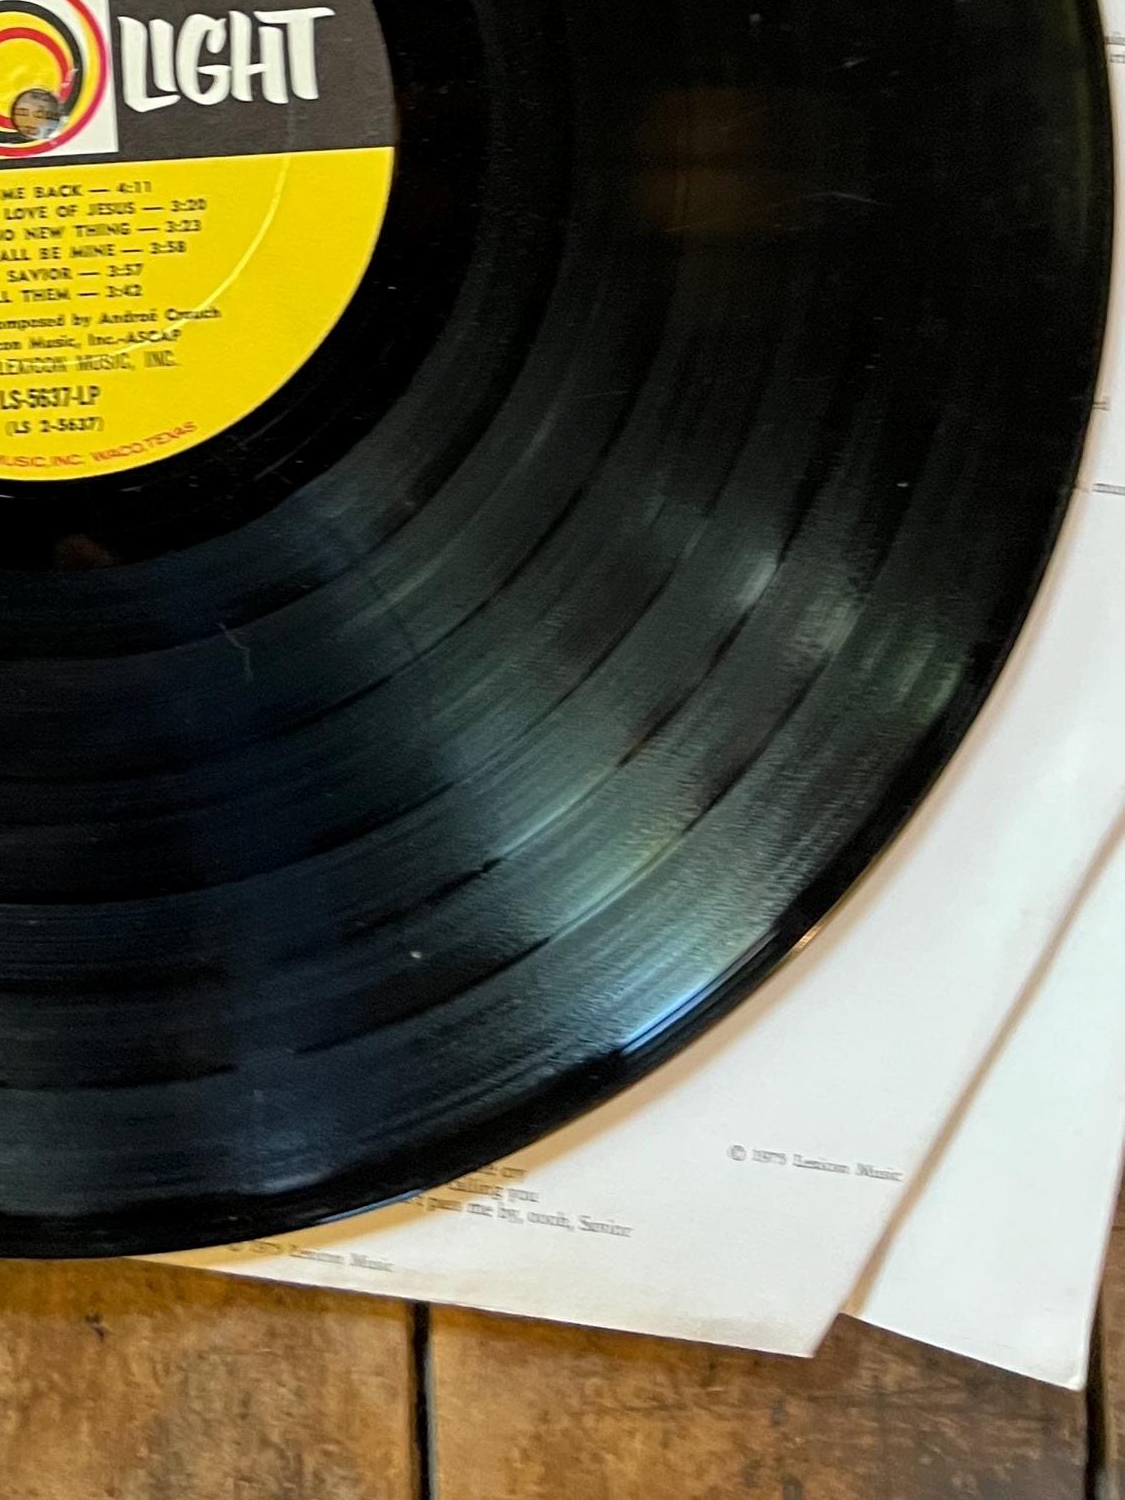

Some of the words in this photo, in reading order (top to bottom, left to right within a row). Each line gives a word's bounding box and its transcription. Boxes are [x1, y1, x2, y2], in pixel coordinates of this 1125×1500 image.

[117, 7, 336, 113] LIGHT
[0, 187, 25, 200] ME
[33, 185, 83, 199] BACK
[116, 181, 152, 194] 4:11
[4, 206, 47, 220] LOVE
[56, 205, 78, 217] OF
[87, 202, 136, 216] JESUS
[25, 226, 65, 240] NEW
[73, 223, 131, 237] THING
[39, 247, 61, 260] BE
[70, 244, 115, 258] MINE
[7, 268, 72, 282] SAVIOR
[21, 288, 71, 301] THEM
[72, 314, 92, 327] by
[165, 307, 221, 321] Crouch
